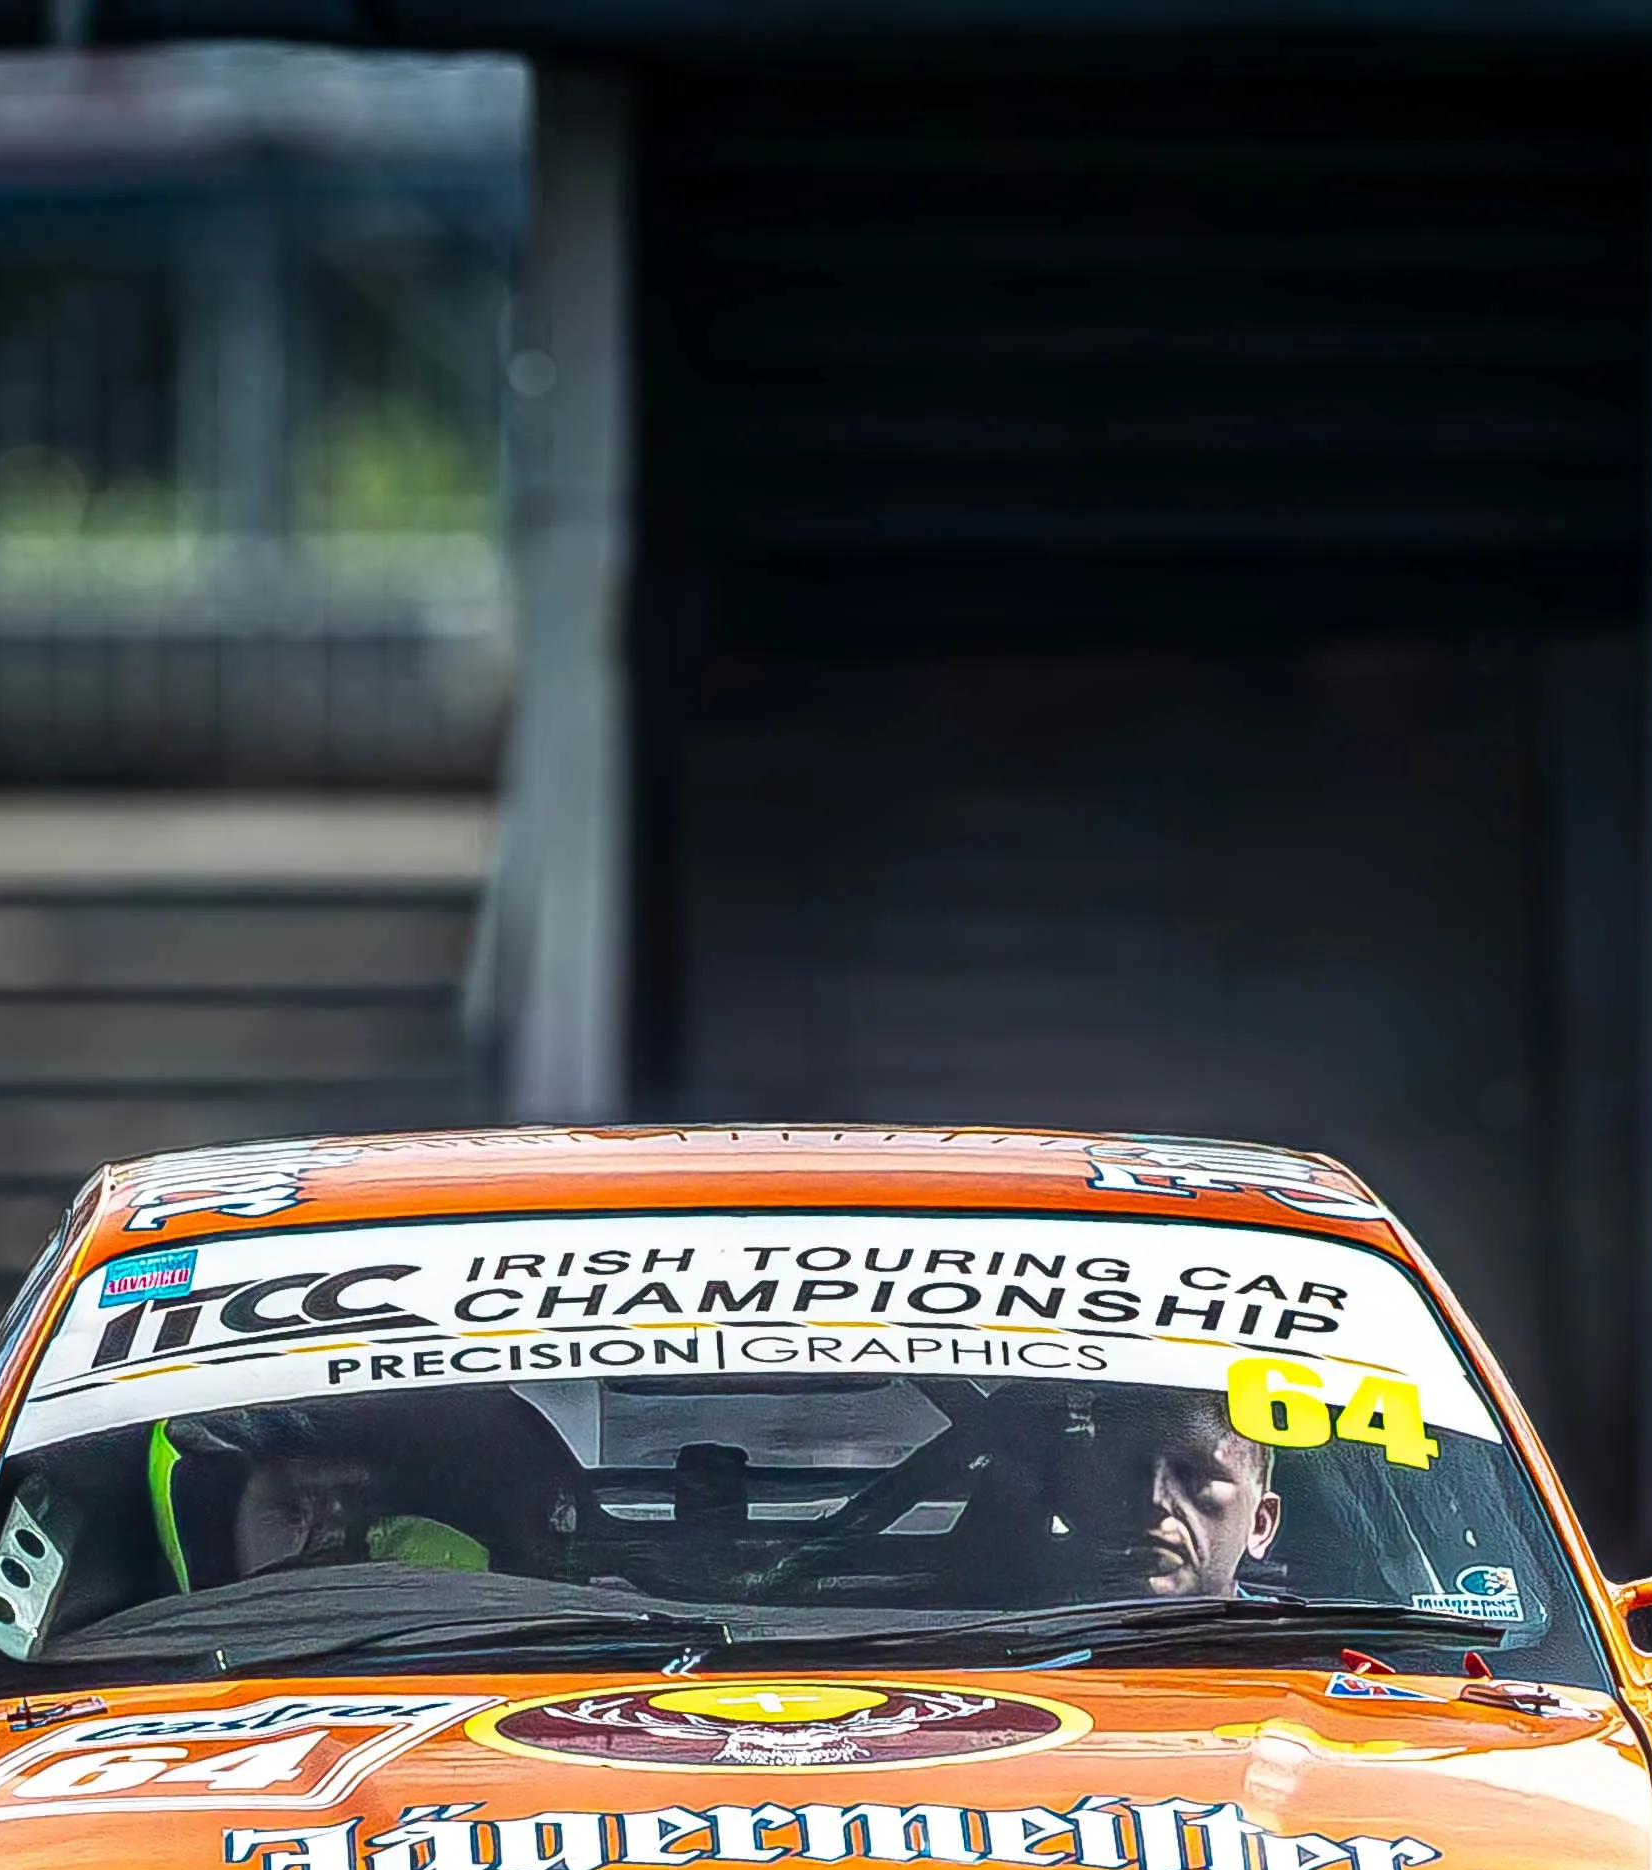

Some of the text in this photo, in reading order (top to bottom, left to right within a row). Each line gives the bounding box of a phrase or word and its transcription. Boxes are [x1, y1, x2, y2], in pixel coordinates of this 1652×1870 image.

[453, 1279, 1340, 1340] CHAMPIONSHIP
[466, 1246, 1349, 1311] IRISH TOURING CAR
[327, 1335, 1108, 1385] PRECISION GRAPHICS
[1227, 1356, 1438, 1470] 64
[12, 1730, 331, 1799] 64
